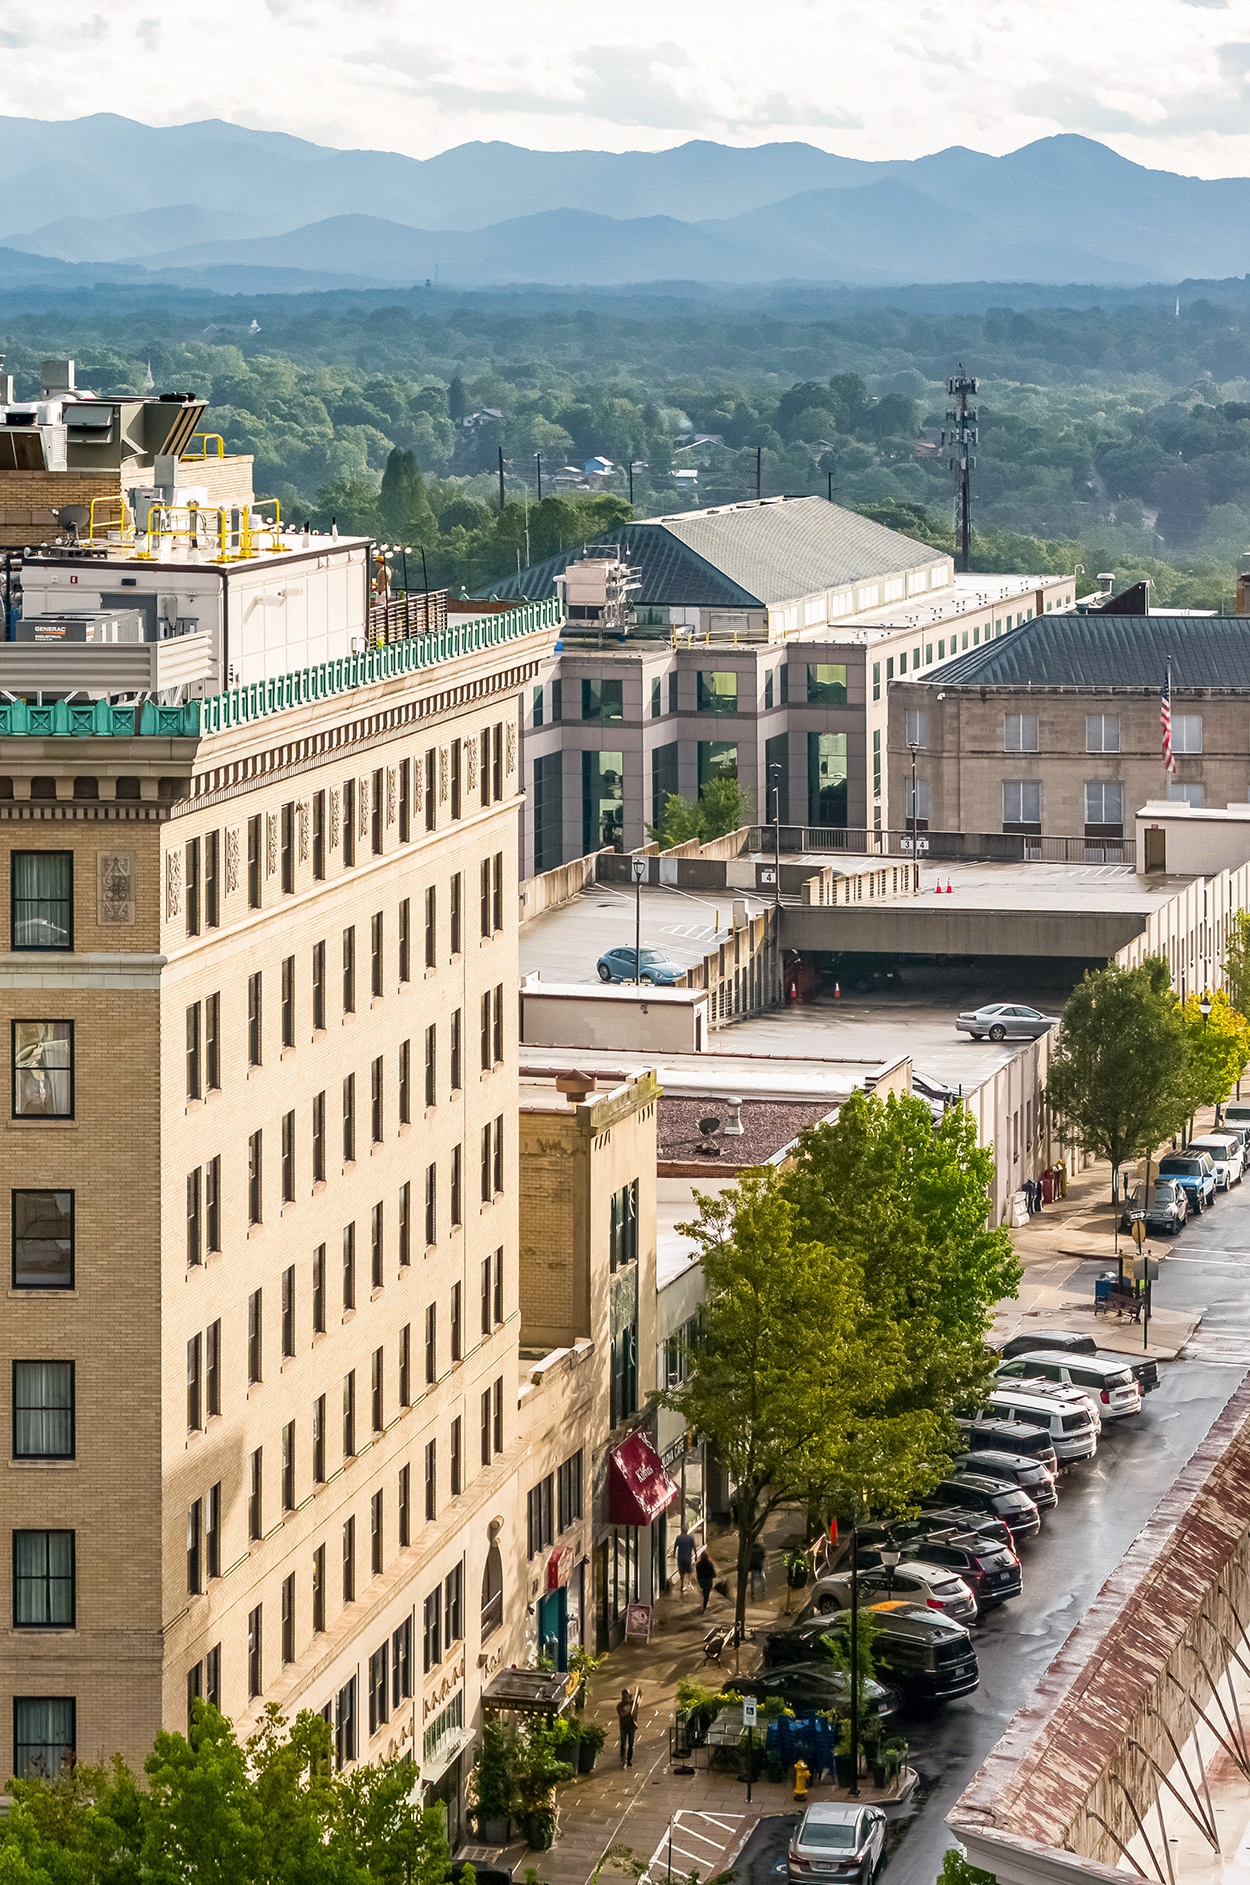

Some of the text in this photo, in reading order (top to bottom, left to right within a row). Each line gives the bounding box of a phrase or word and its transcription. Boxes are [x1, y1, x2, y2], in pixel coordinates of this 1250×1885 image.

[904, 840, 910, 849] 3
[919, 841, 925, 849] 4
[766, 873, 772, 882] 4
